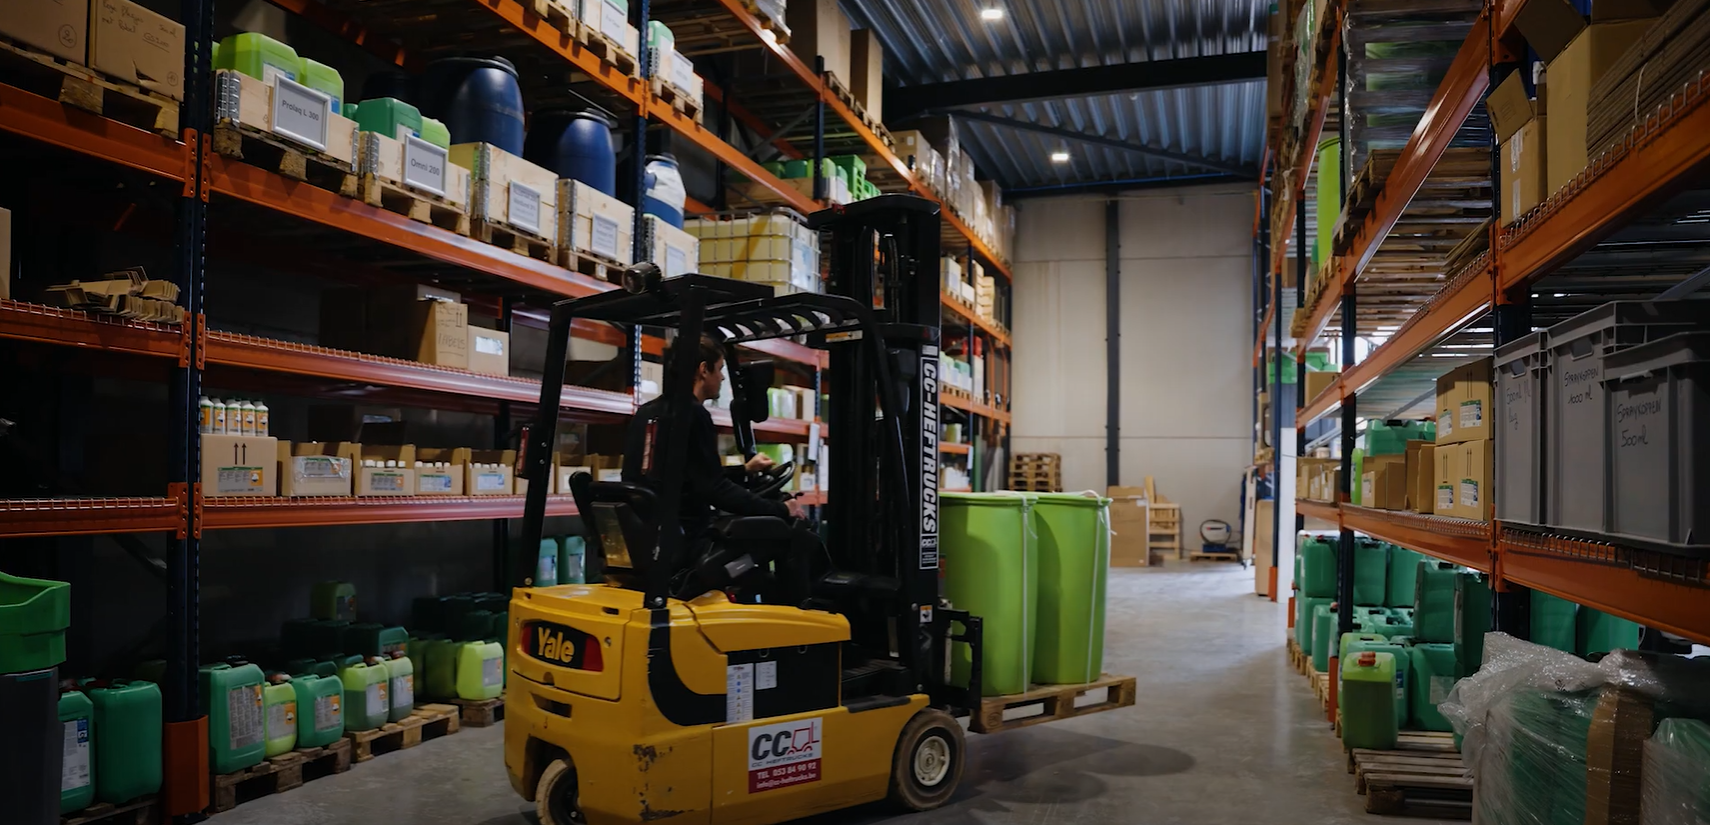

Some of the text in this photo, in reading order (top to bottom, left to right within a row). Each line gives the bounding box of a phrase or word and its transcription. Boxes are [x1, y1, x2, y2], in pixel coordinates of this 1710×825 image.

[303, 109, 308, 117] L
[308, 111, 320, 121] 300
[411, 158, 428, 171] Omni
[923, 361, 937, 533] CC-HEFTRUCKS
[537, 626, 575, 663] Yale
[752, 730, 792, 761] CC
[757, 771, 770, 779] TEL
[773, 768, 786, 776] 053
[787, 765, 796, 774] 84
